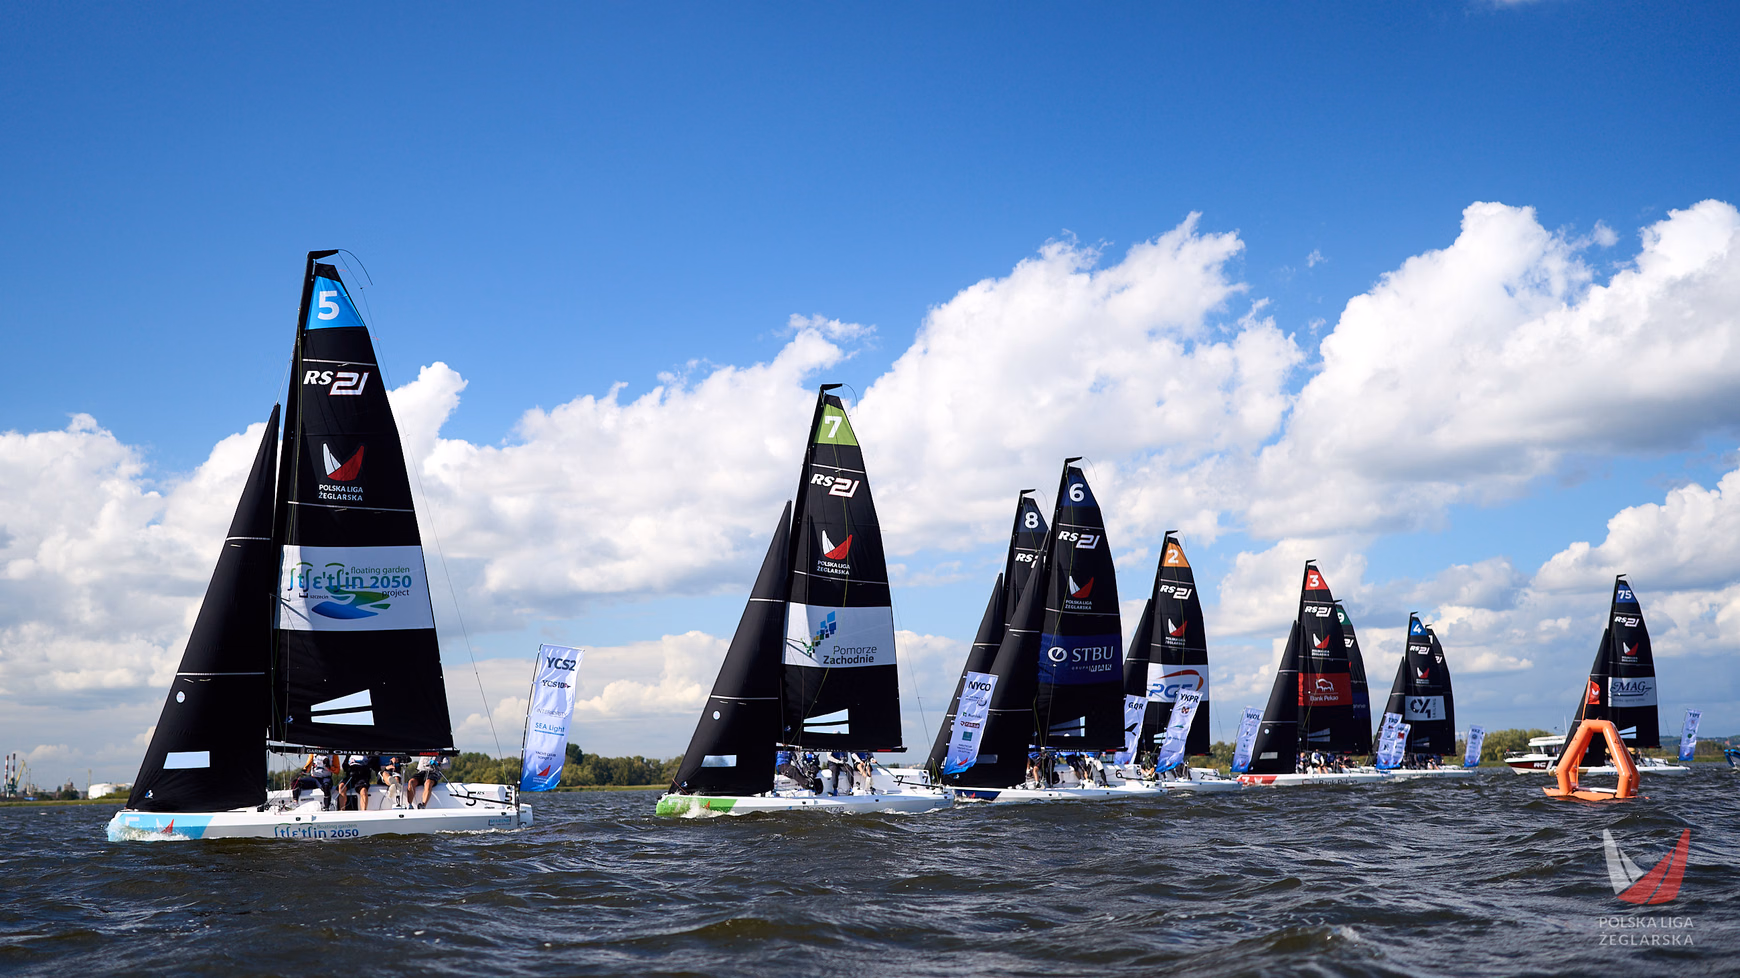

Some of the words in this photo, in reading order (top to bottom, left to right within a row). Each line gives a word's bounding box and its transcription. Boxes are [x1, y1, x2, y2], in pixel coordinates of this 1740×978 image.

[317, 290, 340, 320] 5
[303, 370, 370, 396] RS21
[824, 416, 843, 438] 7
[318, 484, 346, 493] POLSKA
[347, 485, 363, 493] LIGA
[811, 473, 861, 498] RS21
[318, 491, 363, 501] ŻEGLARSKA
[1069, 483, 1085, 502] 6
[1024, 511, 1039, 529] 8
[1058, 530, 1100, 549] RS21
[1167, 549, 1179, 564] 2
[817, 560, 838, 568] POLSKA
[351, 567, 381, 575] floating
[382, 567, 410, 576] garden
[817, 565, 850, 575] ŻEGLARSKA
[370, 575, 412, 589] 2050
[1309, 575, 1320, 588] 3
[381, 589, 410, 598] project
[1413, 624, 1422, 634] 4
[833, 645, 878, 655] Pomorze
[1071, 645, 1114, 662] STBU
[546, 656, 577, 671] YCS2
[823, 655, 874, 665] Zachodnie
[968, 681, 991, 691] NYCO
[1180, 693, 1199, 703] YKPR
[1128, 702, 1144, 710] GQR
[535, 722, 548, 730] SEA
[549, 724, 565, 733] Light
[1115, 770, 1123, 778] 6
[466, 791, 477, 806] 5
[330, 829, 359, 838] 2050
